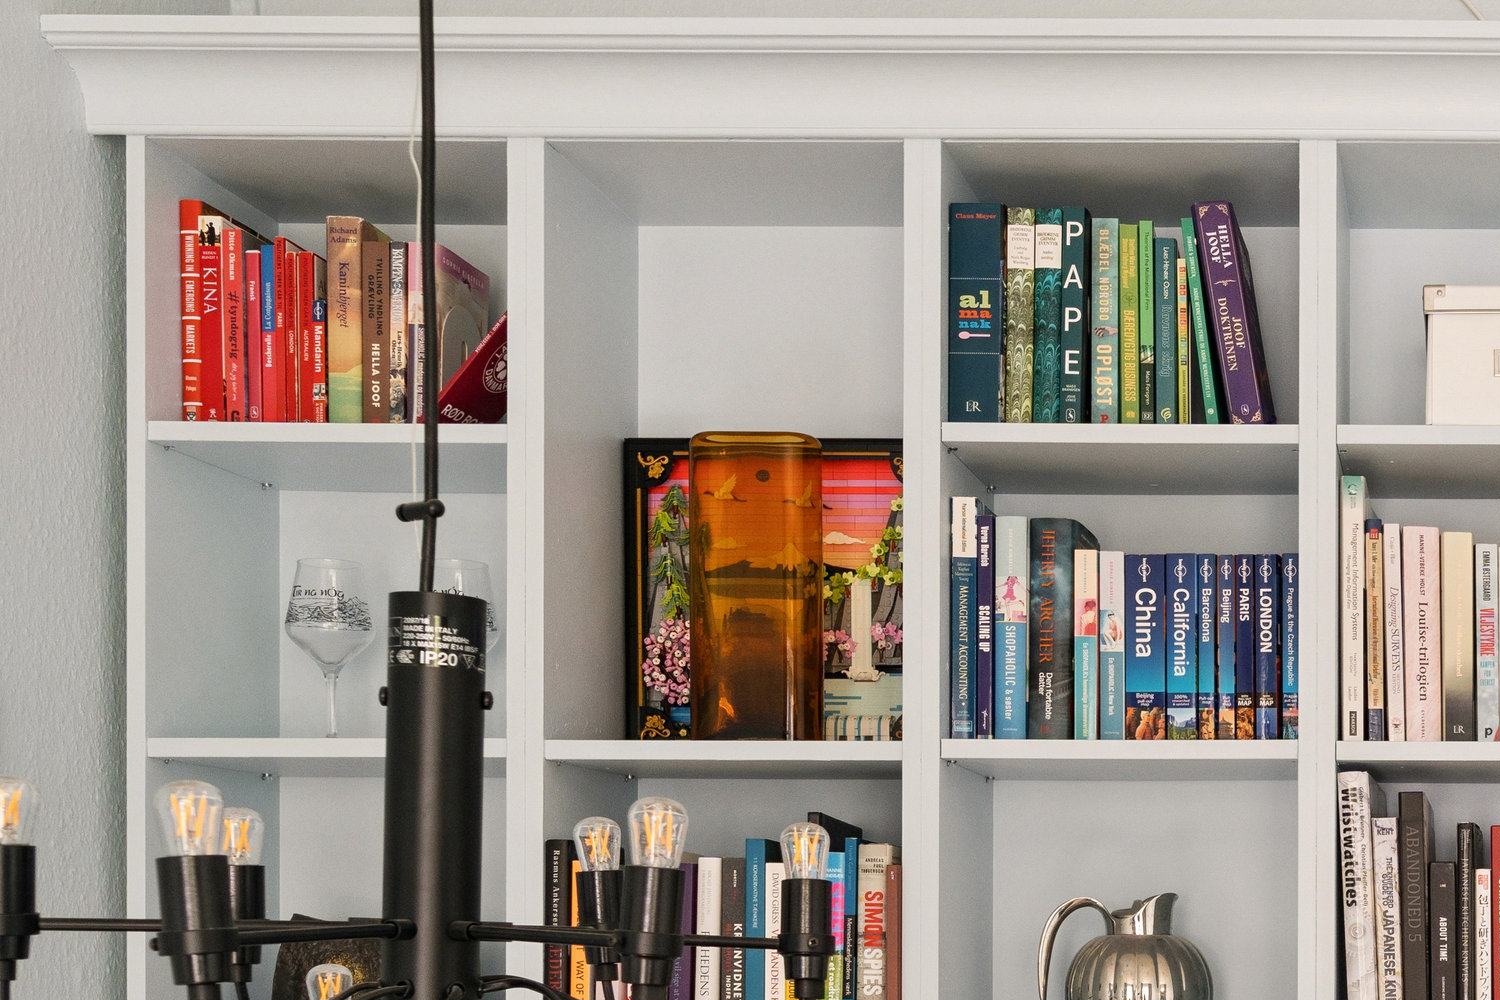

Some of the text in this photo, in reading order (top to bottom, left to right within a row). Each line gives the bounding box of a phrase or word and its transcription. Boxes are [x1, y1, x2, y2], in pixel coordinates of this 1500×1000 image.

[329, 226, 358, 235] Richard
[330, 236, 357, 244] Adams
[1099, 229, 1109, 272] BLÆDEL
[1206, 231, 1221, 264] JOOF
[1217, 224, 1232, 268] HELLA
[185, 280, 195, 312] EMERGING
[203, 267, 217, 314] KINA
[337, 262, 350, 328] Kaninbjerget
[958, 309, 992, 318] ma
[959, 290, 991, 309] al
[185, 325, 195, 354] MARKETS
[958, 319, 991, 329] nak
[1218, 297, 1238, 371] DOKTRINEN
[1232, 317, 1245, 349] JOOF
[314, 325, 323, 373] Mandarin
[1124, 309, 1135, 401] BÆREDYGTIG BUSINESS
[371, 343, 380, 408] HELLA JOOF
[1095, 344, 1112, 405] OPLØST
[959, 585, 969, 643] MANAGEMENT
[1040, 529, 1056, 664] JEFFREY ARCHER
[1202, 587, 1212, 642] Barcelona
[1220, 588, 1232, 623] Beijing
[1239, 587, 1250, 621] PARIS
[1260, 587, 1272, 652] LONDON
[979, 605, 990, 653] SCALING UP
[1135, 587, 1157, 658] China
[1173, 587, 1189, 677] California
[1388, 586, 1401, 672] Designing SURVEYS
[1480, 607, 1495, 657] VILJESTYRKE
[420, 650, 458, 666] IP20
[959, 644, 969, 700] ACCOUNTING
[1416, 601, 1428, 702] Louise-trilogien
[1038, 671, 1046, 696] datter
[1045, 672, 1053, 720] Den fortabte
[1341, 786, 1358, 908] Wristwatches
[1376, 827, 1394, 836] KENT
[1406, 826, 1421, 942] ABANDONED 5
[864, 891, 884, 996] SIMON SPIES
[1382, 909, 1395, 976] JAPANESE
[1439, 916, 1448, 962] ABOUT TIME
